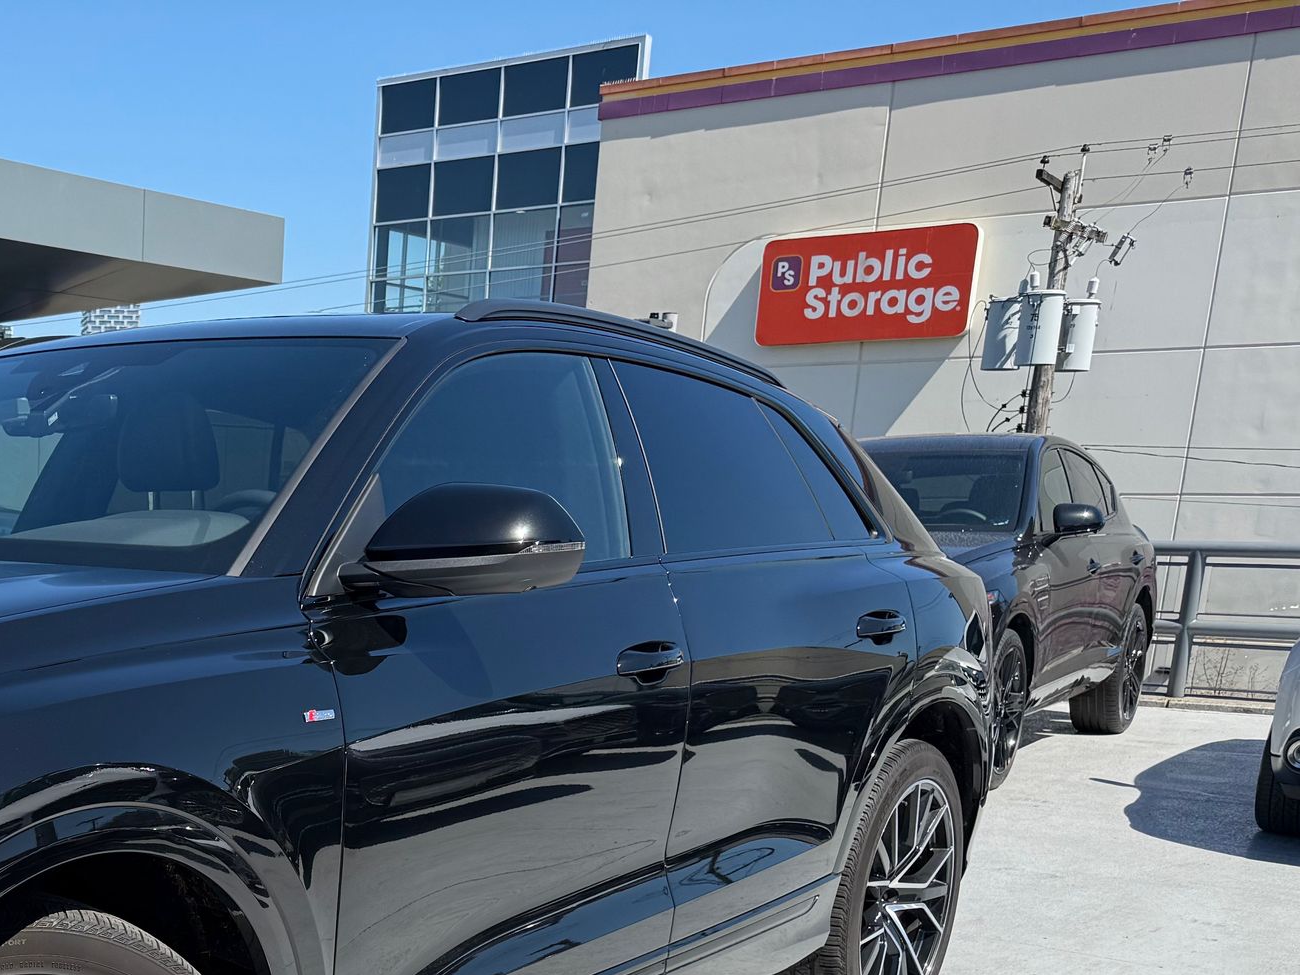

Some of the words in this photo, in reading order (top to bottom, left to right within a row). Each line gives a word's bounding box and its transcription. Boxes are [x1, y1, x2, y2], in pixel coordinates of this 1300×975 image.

[777, 261, 795, 285] PS
[808, 248, 933, 286] Public
[804, 285, 960, 324] Storage
